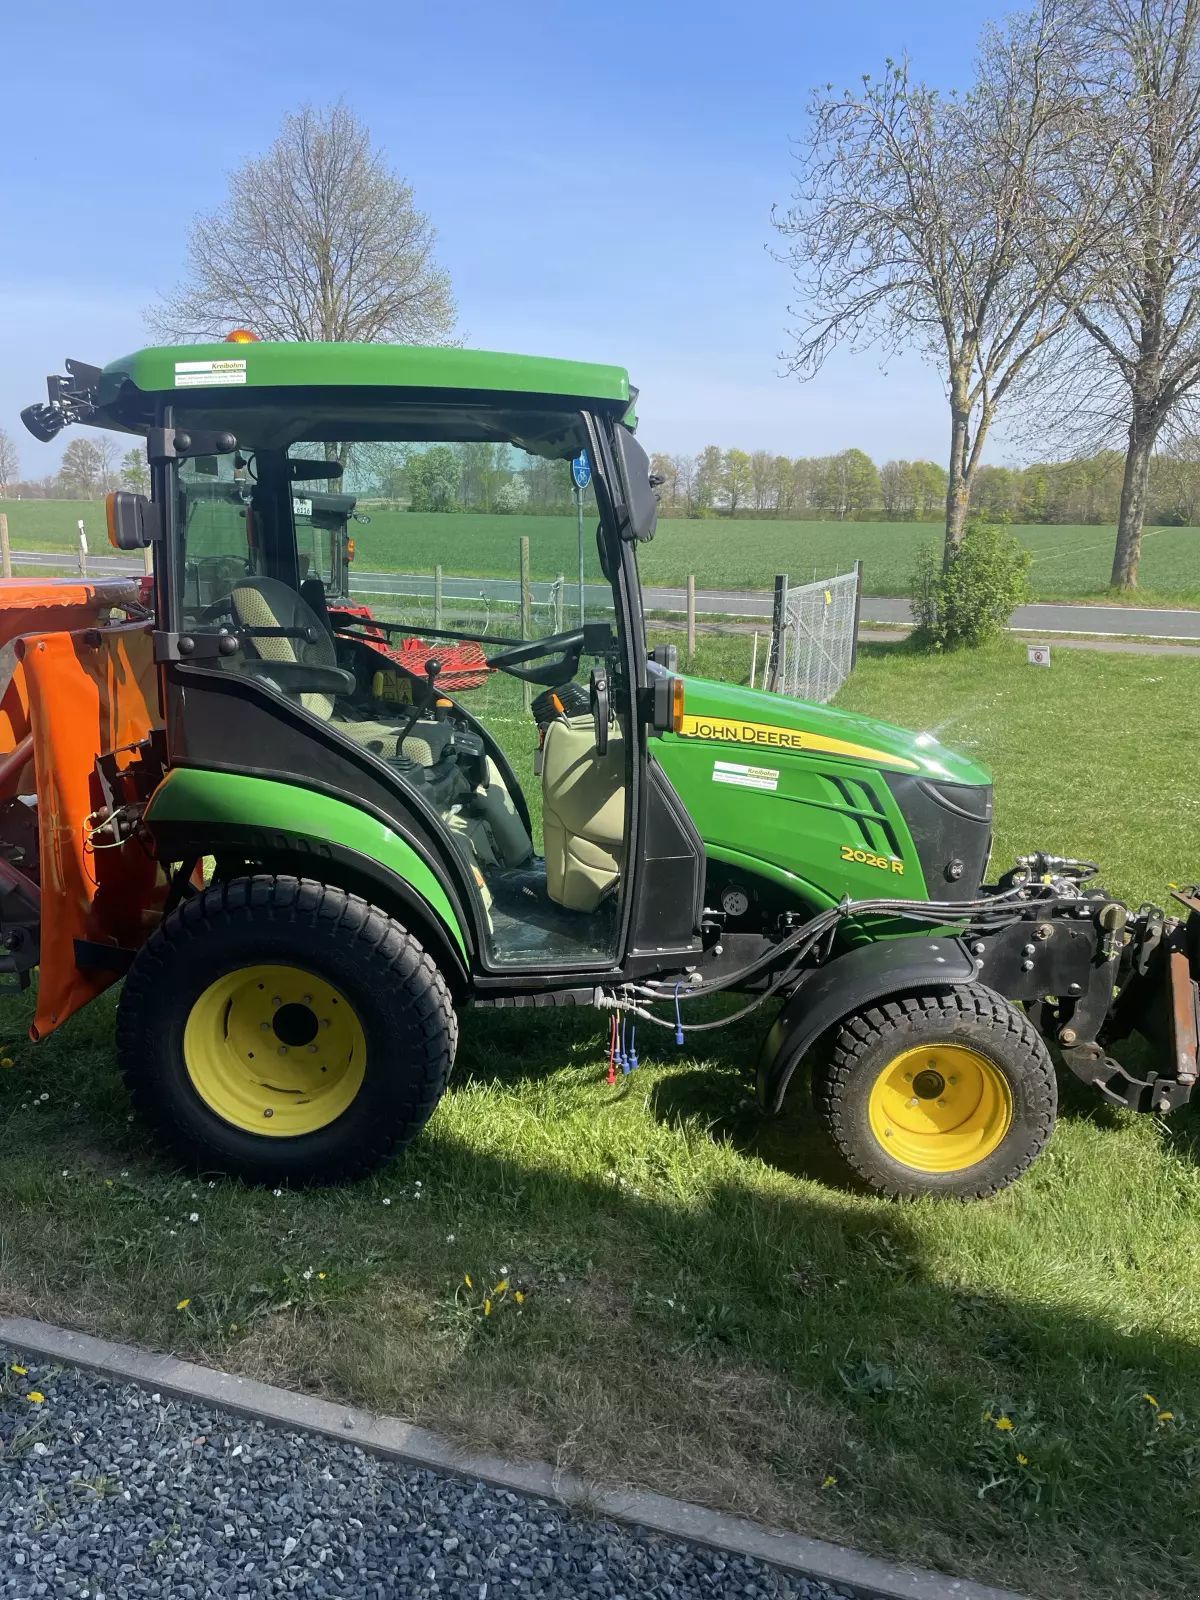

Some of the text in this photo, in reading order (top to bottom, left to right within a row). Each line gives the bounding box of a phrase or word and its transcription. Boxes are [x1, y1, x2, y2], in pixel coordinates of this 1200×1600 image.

[211, 362, 244, 370] Kreibohm
[689, 721, 802, 747] JOHN DEERE
[747, 767, 777, 778] Kreibohm
[841, 846, 905, 875] 2026 R
